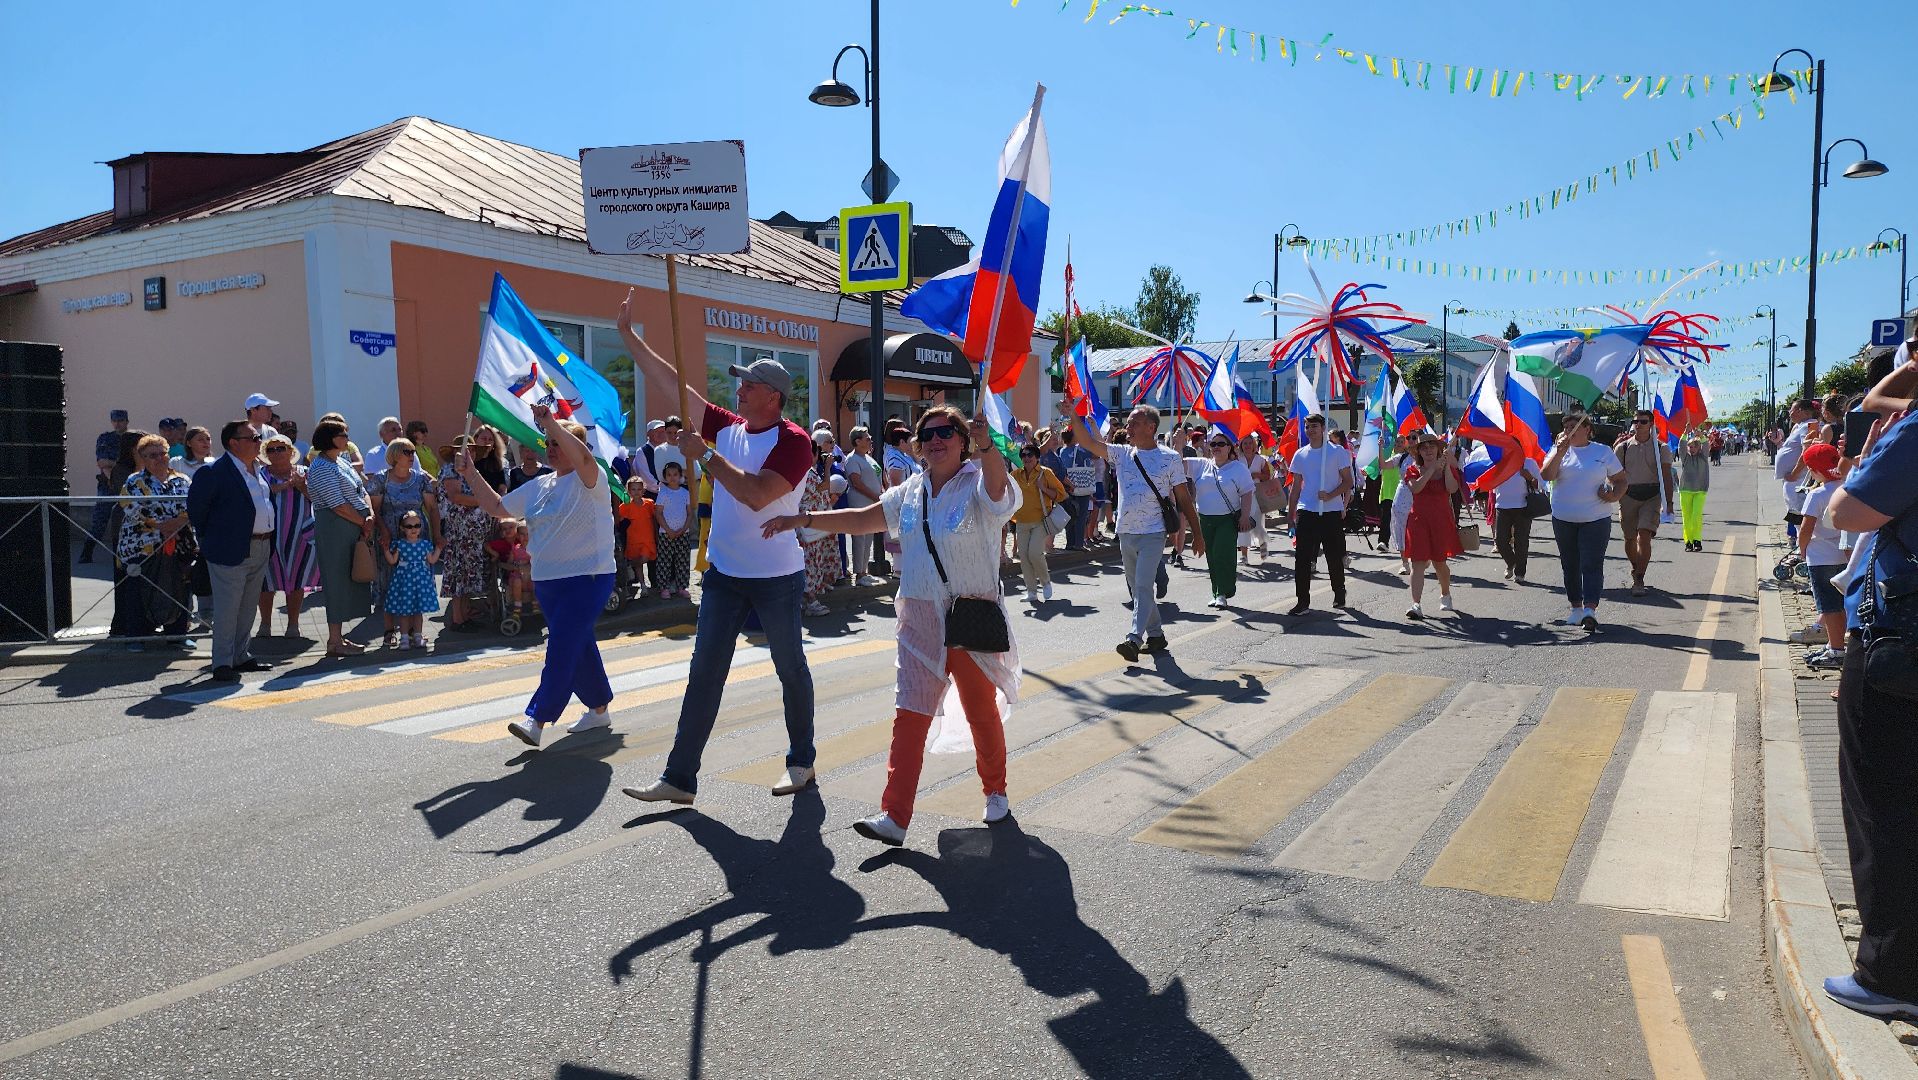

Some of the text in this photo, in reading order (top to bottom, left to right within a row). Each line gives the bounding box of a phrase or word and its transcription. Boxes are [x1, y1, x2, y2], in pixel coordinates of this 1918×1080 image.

[590, 184, 738, 199] Центр культурных инициатив
[599, 199, 730, 215] городского округа Кашира
[353, 335, 392, 346] Советская
[1880, 322, 1898, 344] P
[370, 346, 380, 354] 19
[915, 347, 953, 365] ЦВЕТЫ
